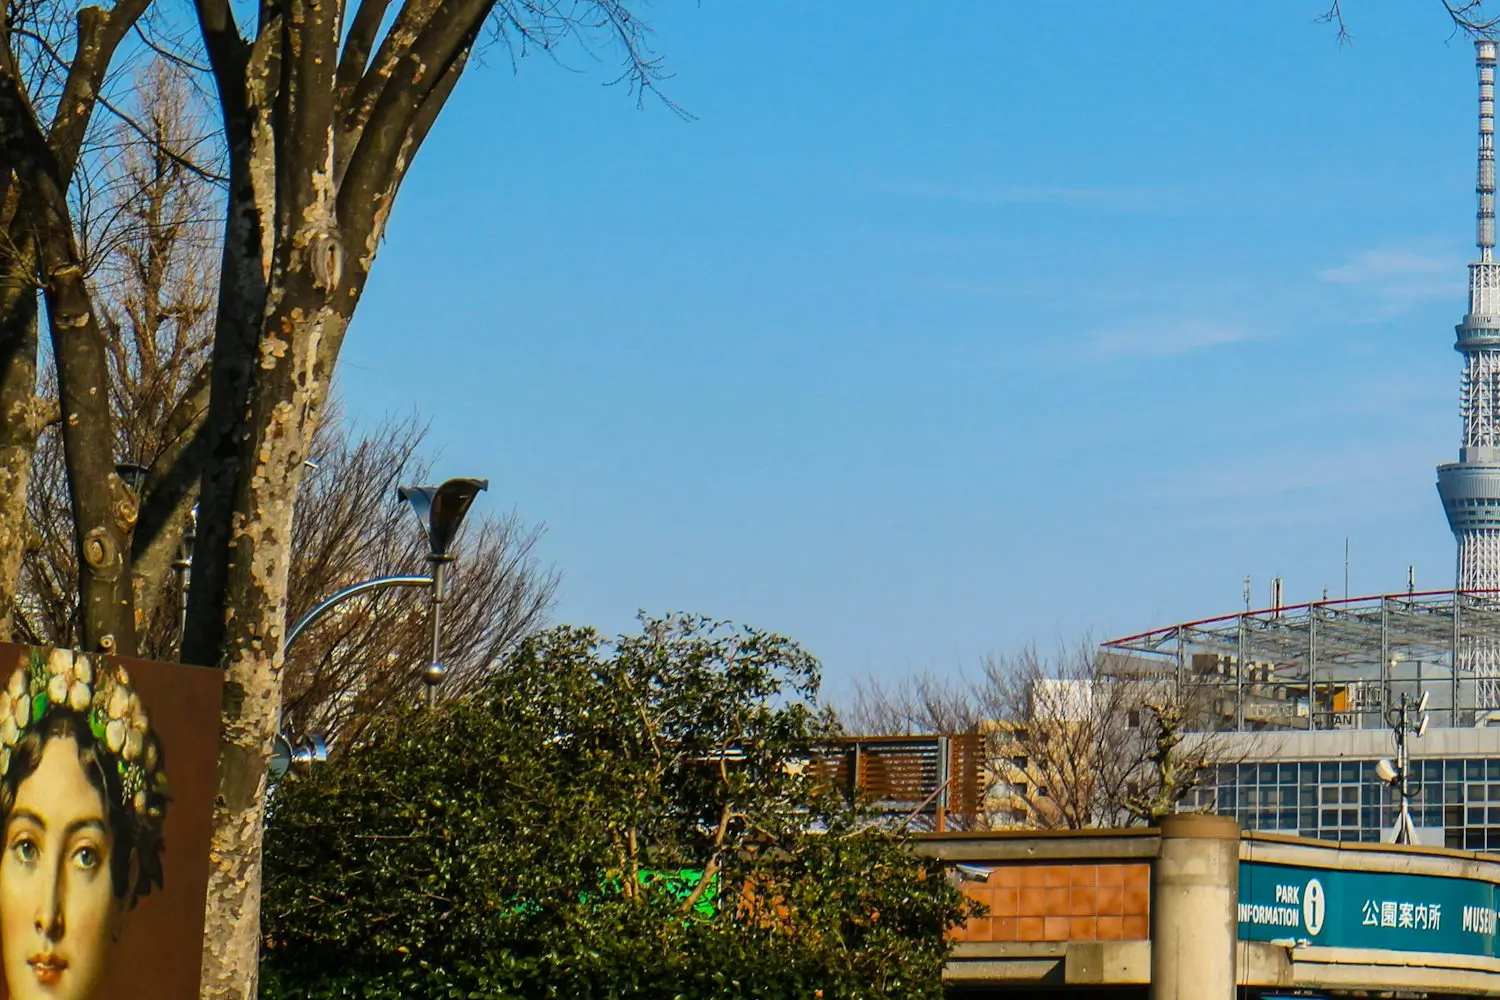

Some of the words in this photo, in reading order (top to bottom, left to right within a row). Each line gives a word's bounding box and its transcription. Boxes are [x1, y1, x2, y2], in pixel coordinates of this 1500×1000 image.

[1275, 884, 1300, 904] PARK
[1237, 903, 1299, 927] INFORMATION
[1362, 899, 1442, 931] 公園案内所
